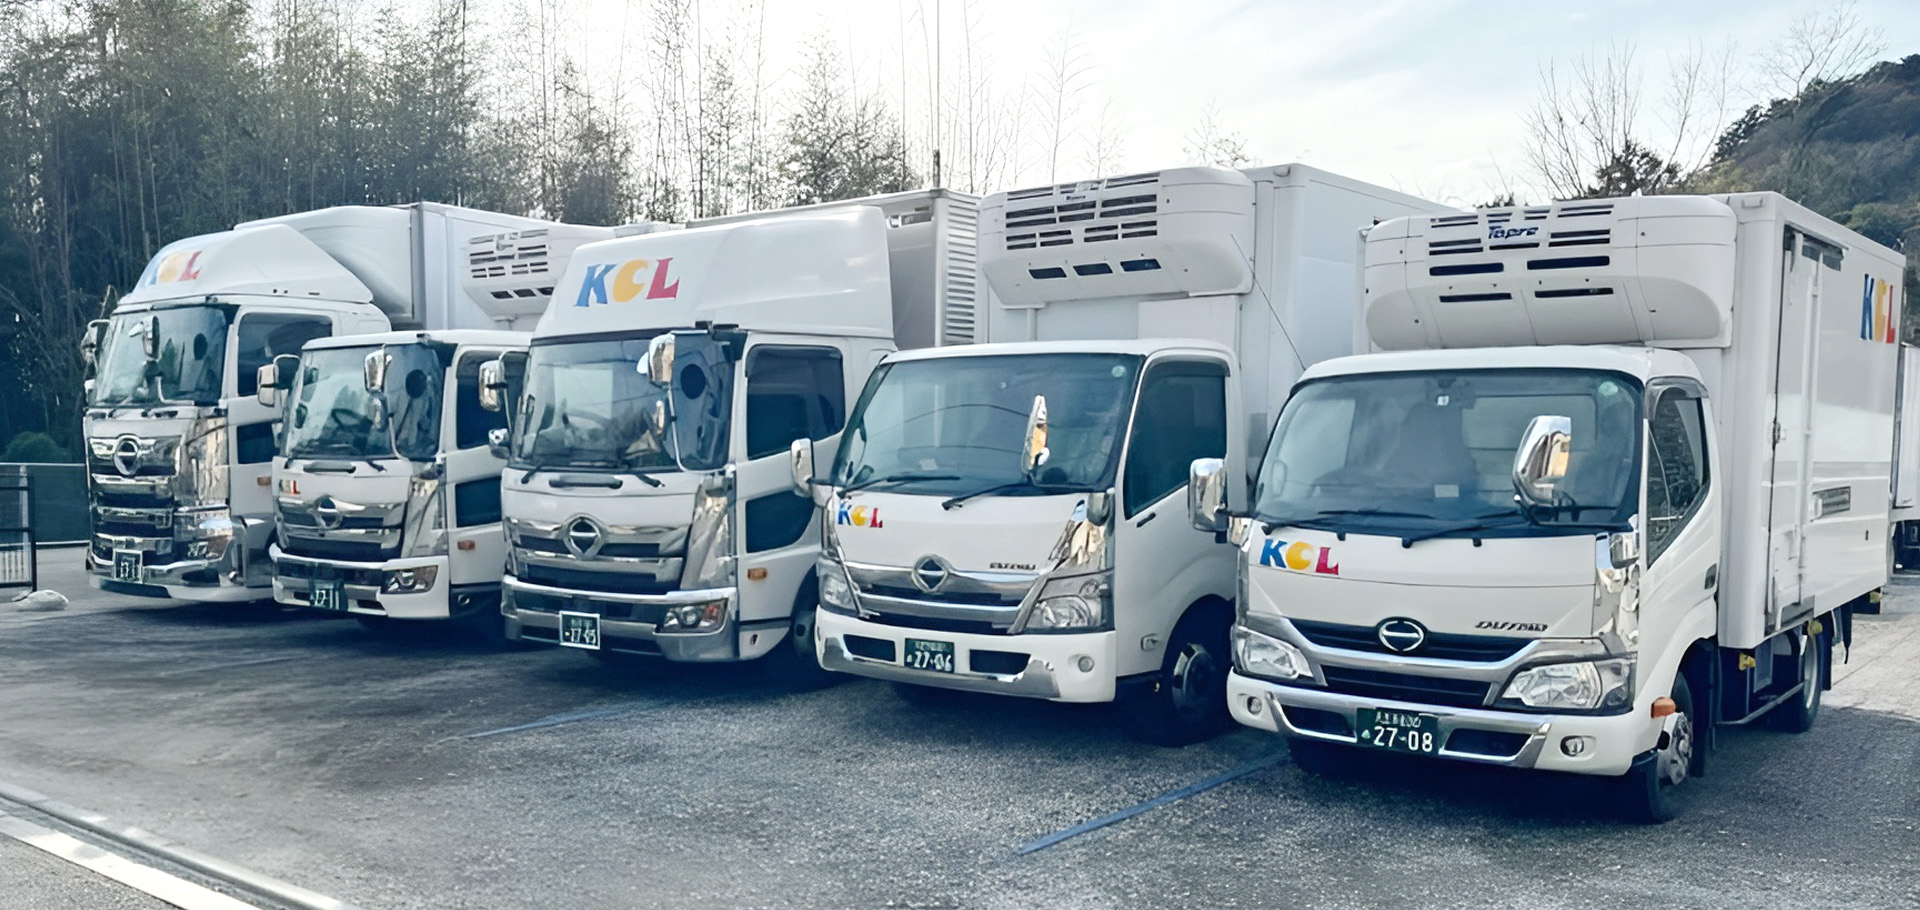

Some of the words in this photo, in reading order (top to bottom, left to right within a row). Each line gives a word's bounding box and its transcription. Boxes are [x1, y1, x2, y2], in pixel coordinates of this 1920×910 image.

[574, 257, 681, 307] KCL
[1860, 273, 1896, 344] KCL
[838, 501, 883, 528] KCL
[1260, 538, 1339, 575] KCL
[914, 651, 952, 671] 27-06
[1374, 725, 1433, 753] 27-08
